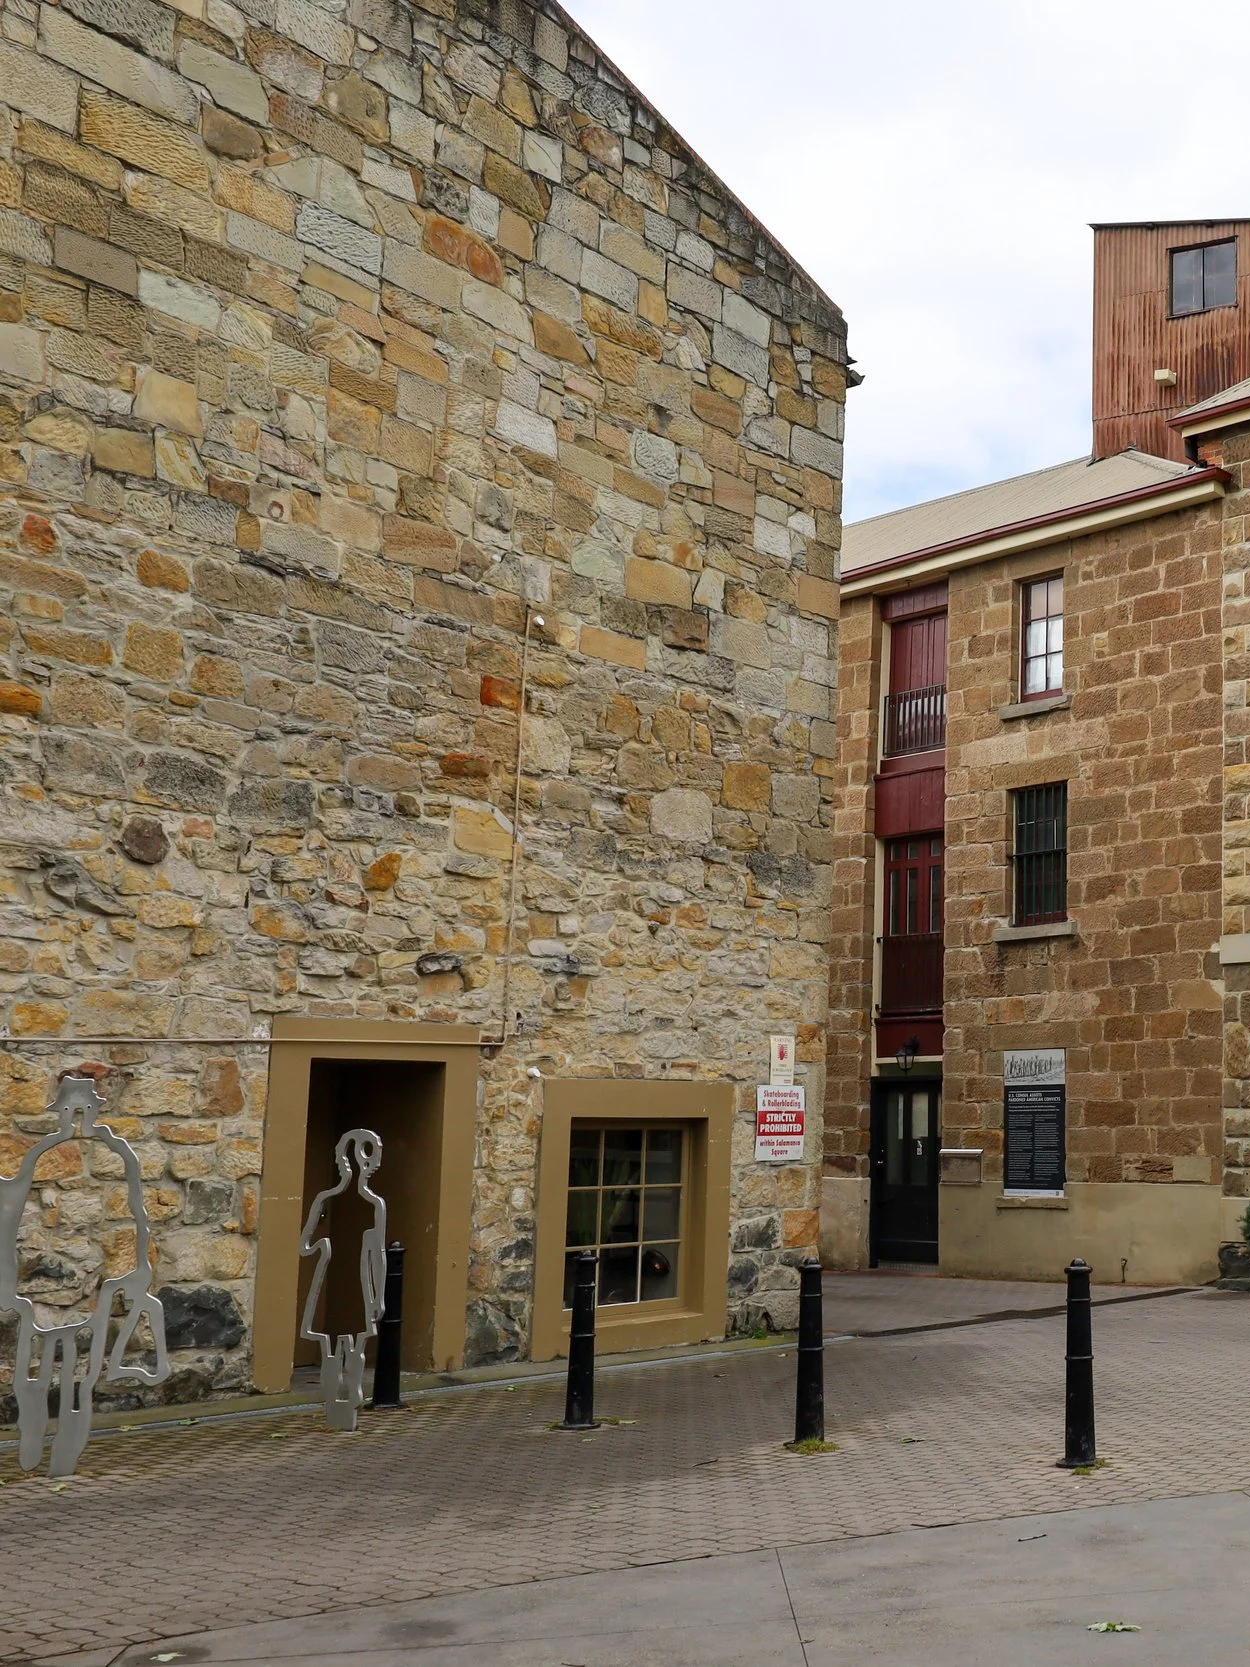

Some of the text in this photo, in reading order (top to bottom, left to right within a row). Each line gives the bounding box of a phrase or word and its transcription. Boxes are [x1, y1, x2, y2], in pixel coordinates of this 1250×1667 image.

[763, 1090, 799, 1099] Skateboarding
[767, 1100, 801, 1109] Rollerblading
[766, 1112, 797, 1122] STRICTLY
[760, 1123, 802, 1133] PROHIBITED
[760, 1139, 775, 1147] within
[771, 1148, 788, 1157] Square
